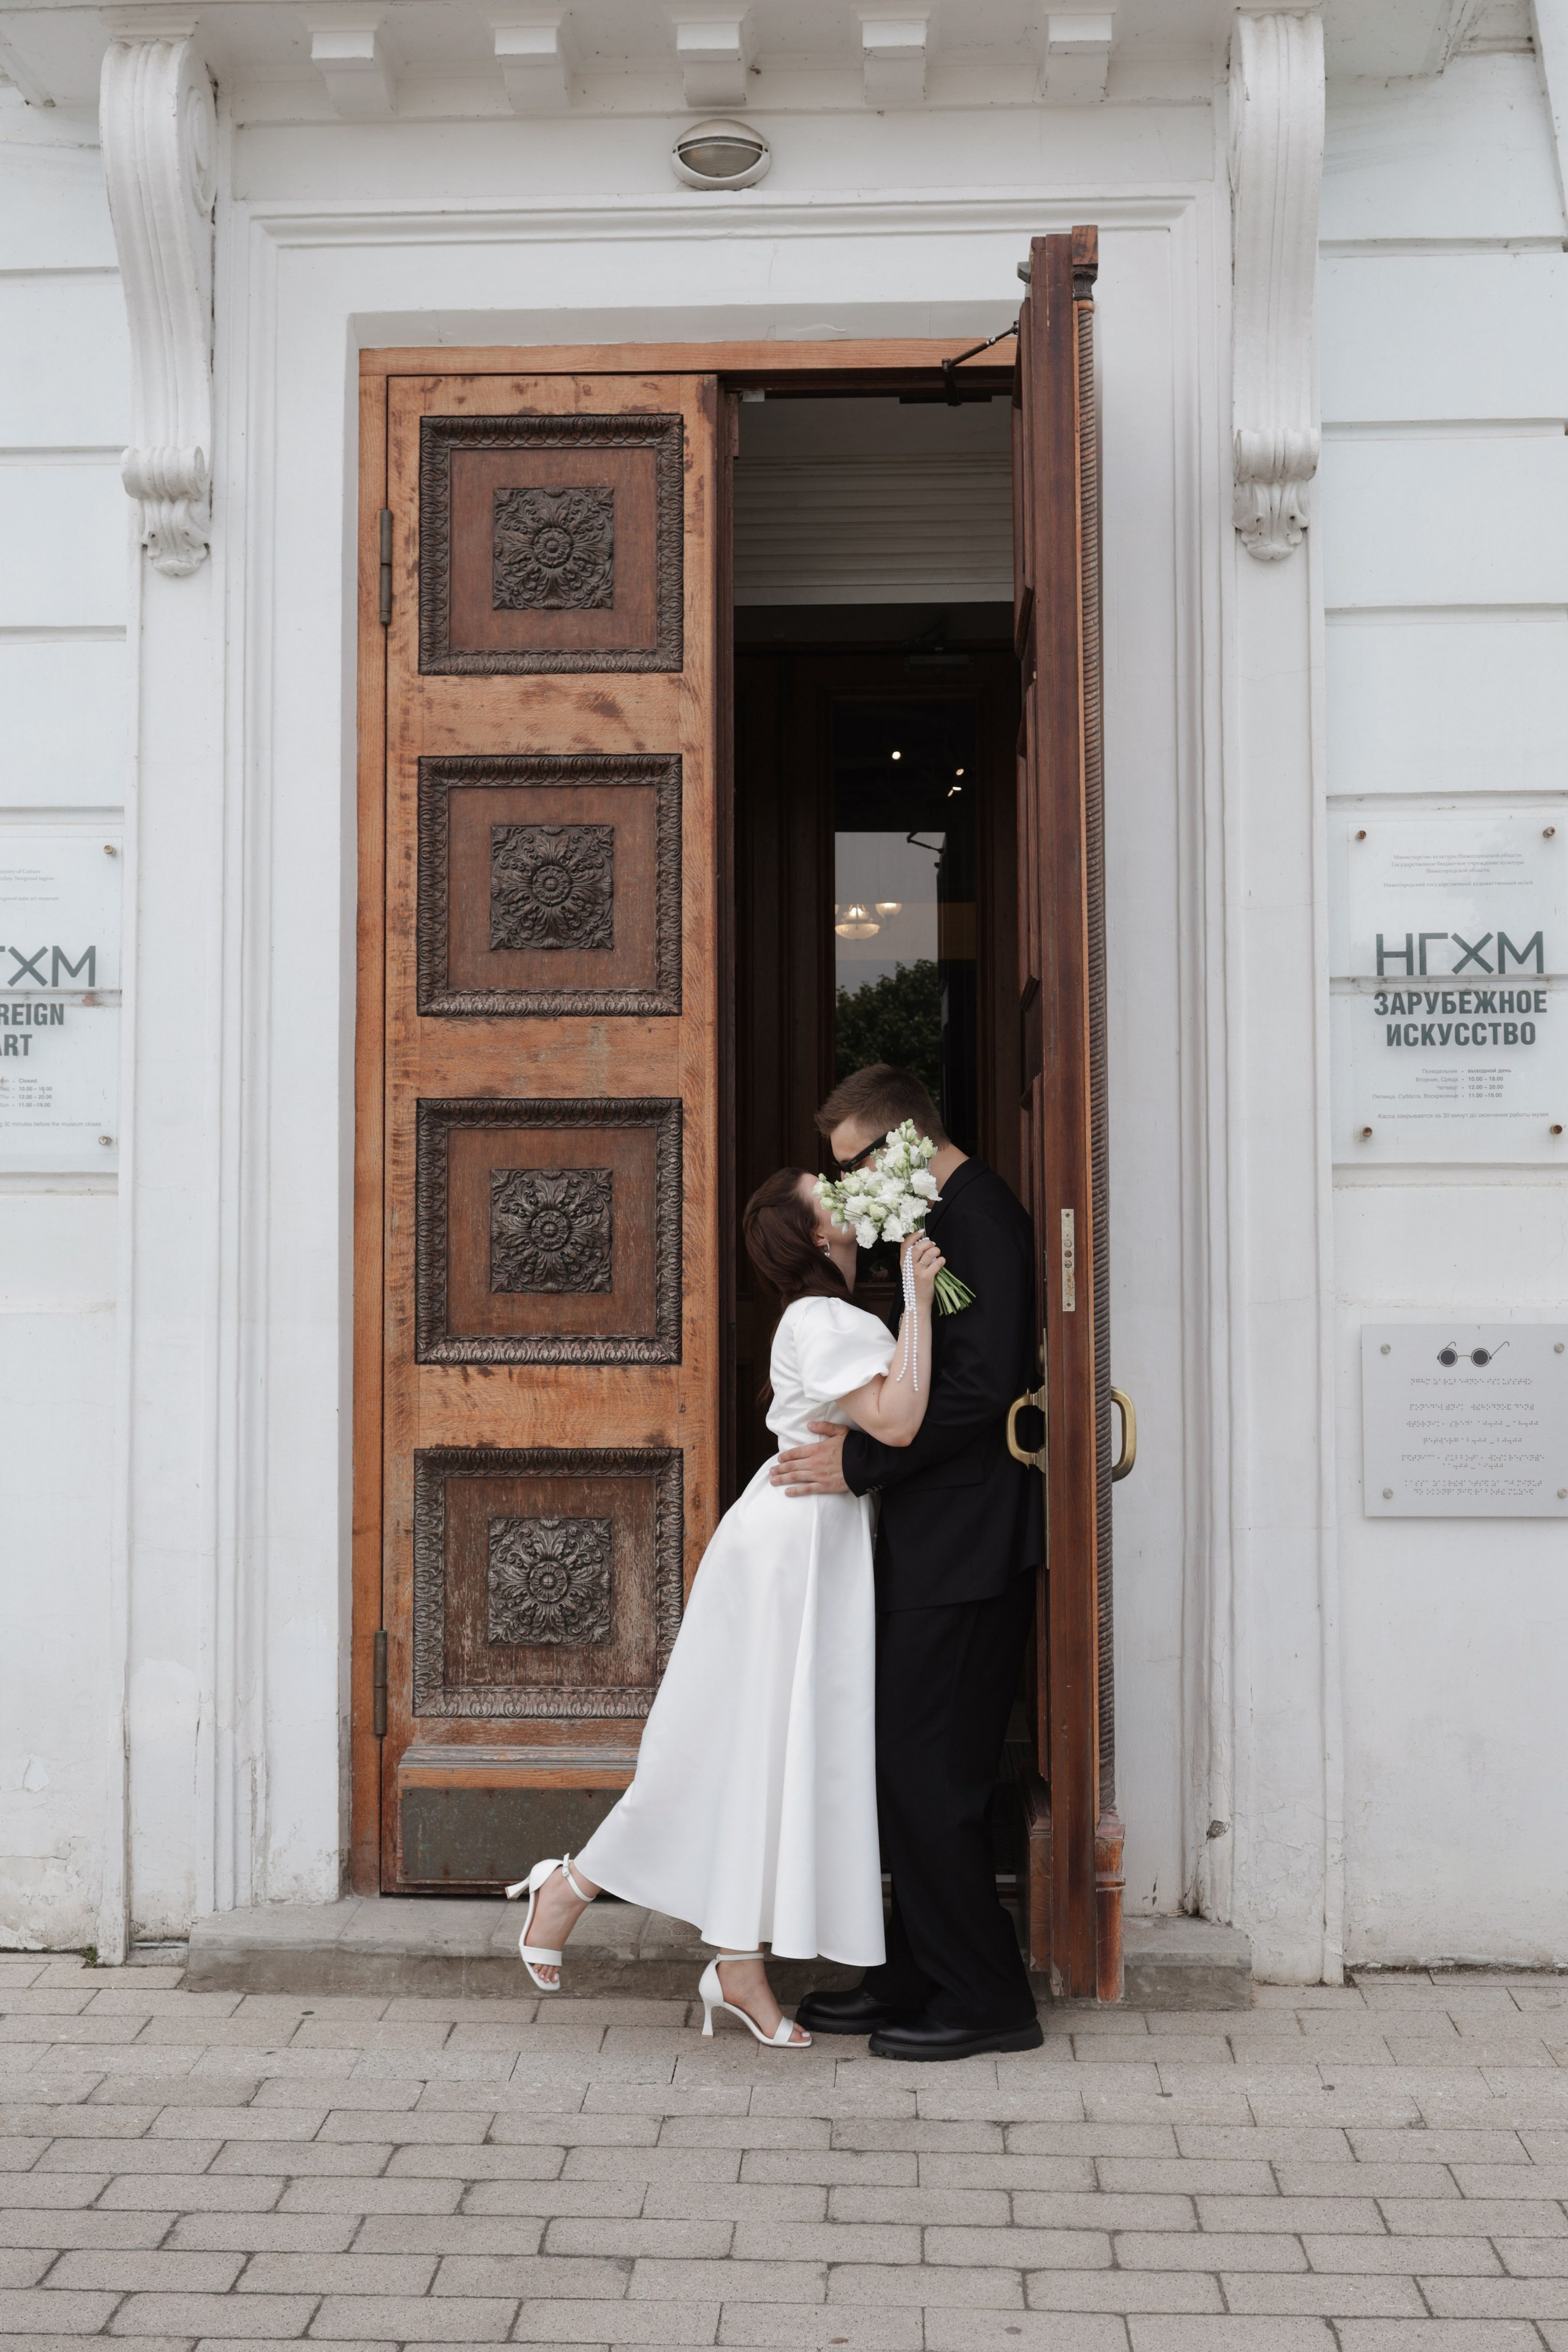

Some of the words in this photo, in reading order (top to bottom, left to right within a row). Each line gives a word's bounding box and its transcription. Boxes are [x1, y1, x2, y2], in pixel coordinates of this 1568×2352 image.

[1376, 931, 1544, 976] НГХМ
[1374, 990, 1547, 1016] ЗАРУБЕЖНОЕ
[0, 1034, 33, 1056] RT
[1386, 1022, 1536, 1047] ИСКУССТВО
